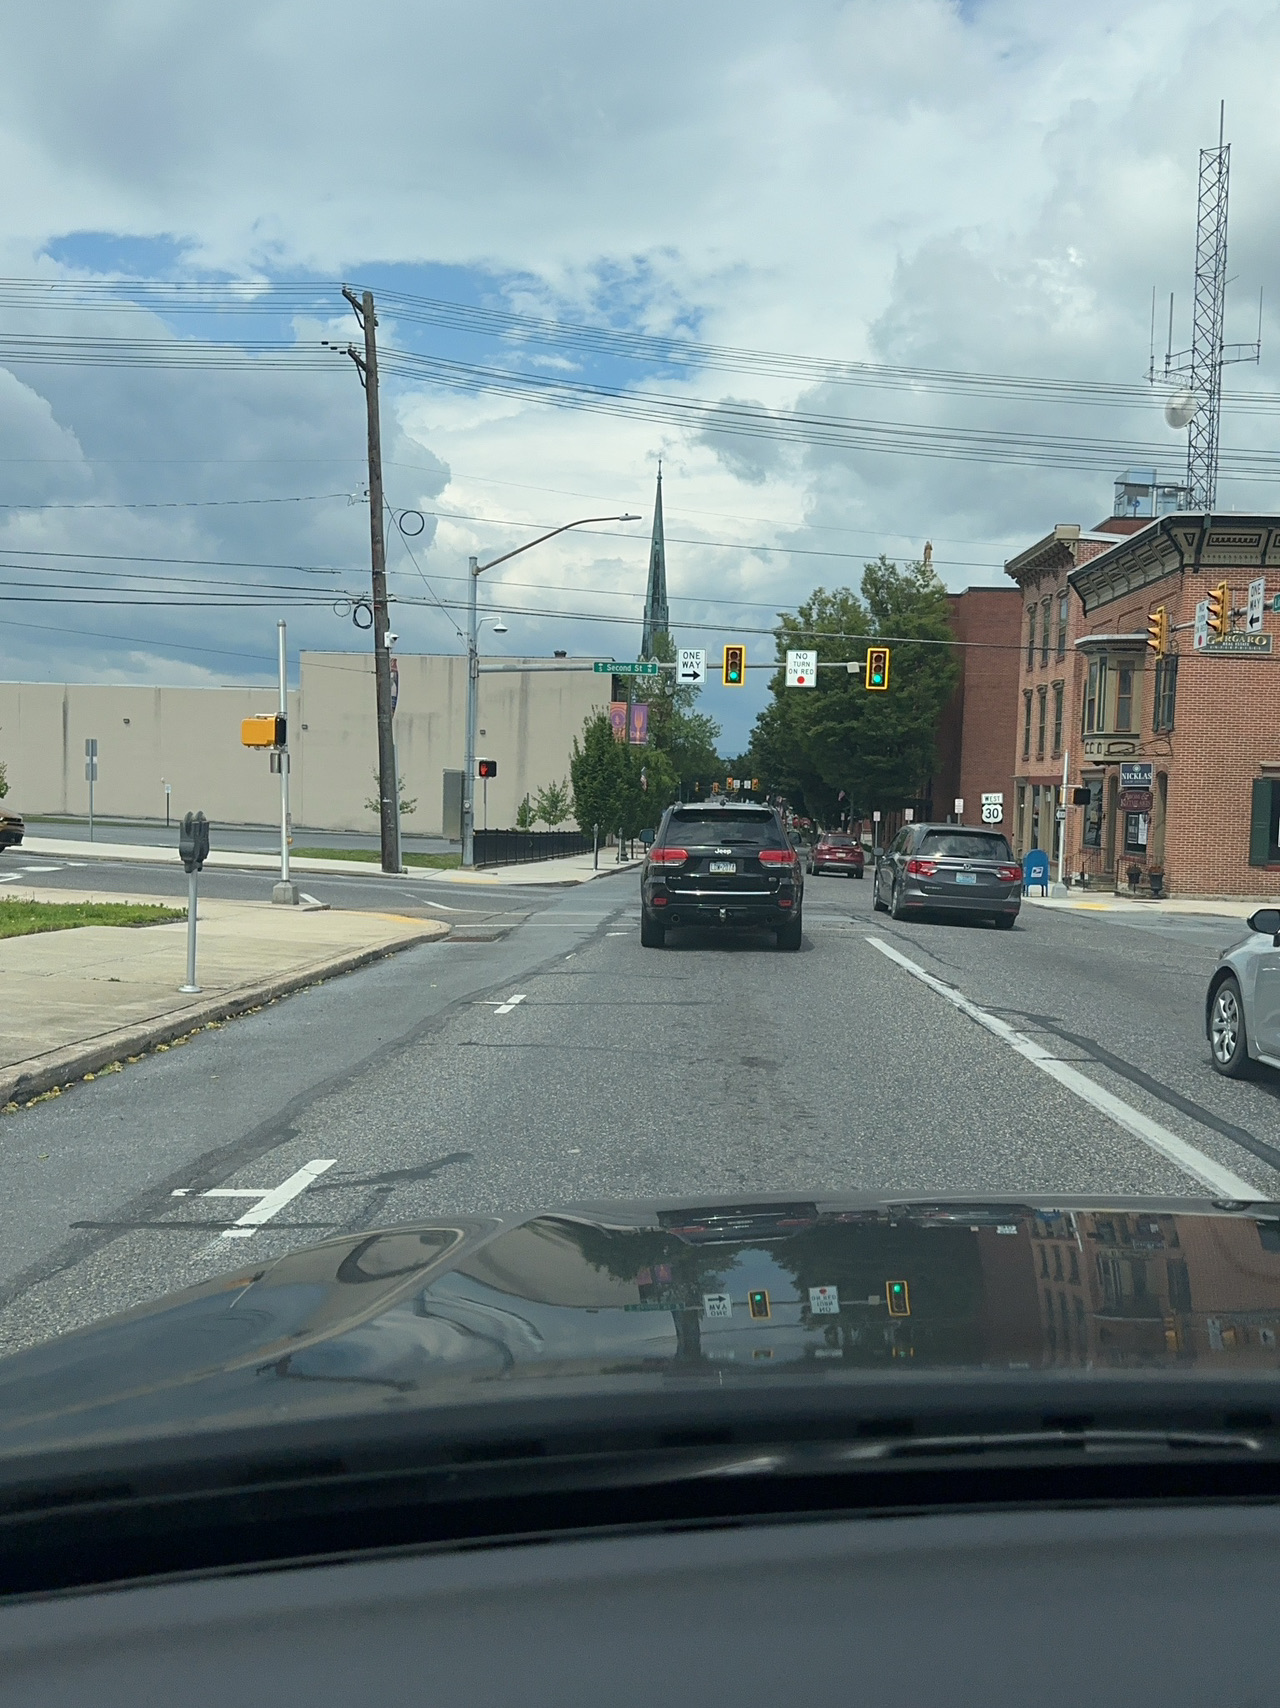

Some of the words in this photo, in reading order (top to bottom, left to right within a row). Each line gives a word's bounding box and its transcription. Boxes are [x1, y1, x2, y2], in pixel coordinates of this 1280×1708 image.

[1251, 583, 1261, 598] ONE
[1250, 598, 1262, 612] WAY
[682, 652, 701, 660] ONE
[606, 664, 632, 672] Second
[682, 661, 702, 669] WAY
[986, 808, 999, 819] 30
